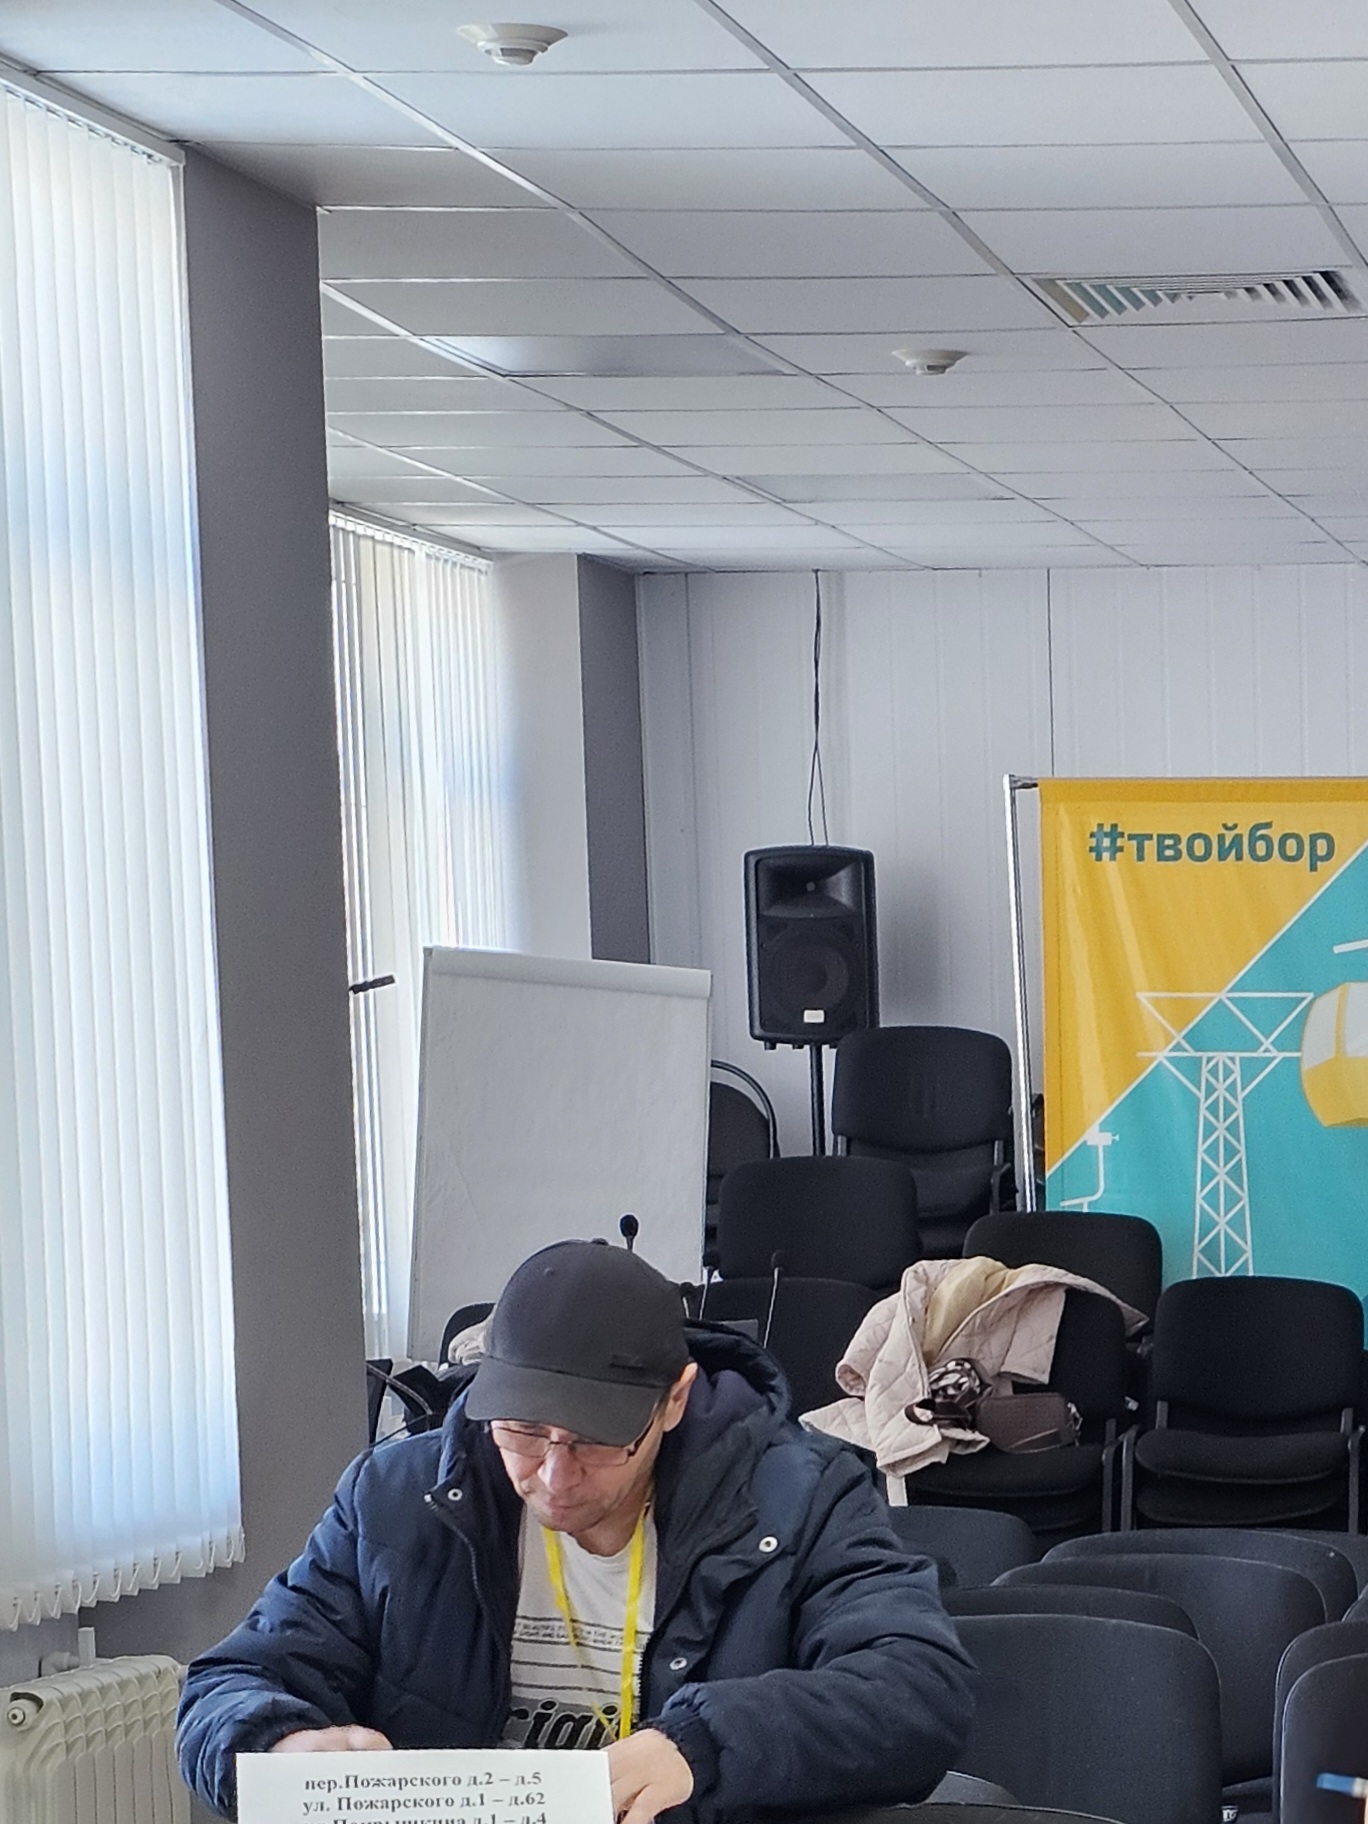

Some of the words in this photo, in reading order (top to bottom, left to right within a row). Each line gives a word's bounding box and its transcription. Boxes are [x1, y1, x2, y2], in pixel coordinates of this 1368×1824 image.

[1089, 821, 1335, 872] #твойбор
[305, 1775, 462, 1793] пер.Пожарского
[467, 1772, 493, 1787] д.2
[515, 1772, 542, 1786] д.5
[303, 1801, 330, 1816] ул.
[337, 1797, 454, 1813] Пожарского
[460, 1793, 485, 1807] д.1
[508, 1792, 546, 1807] д.62
